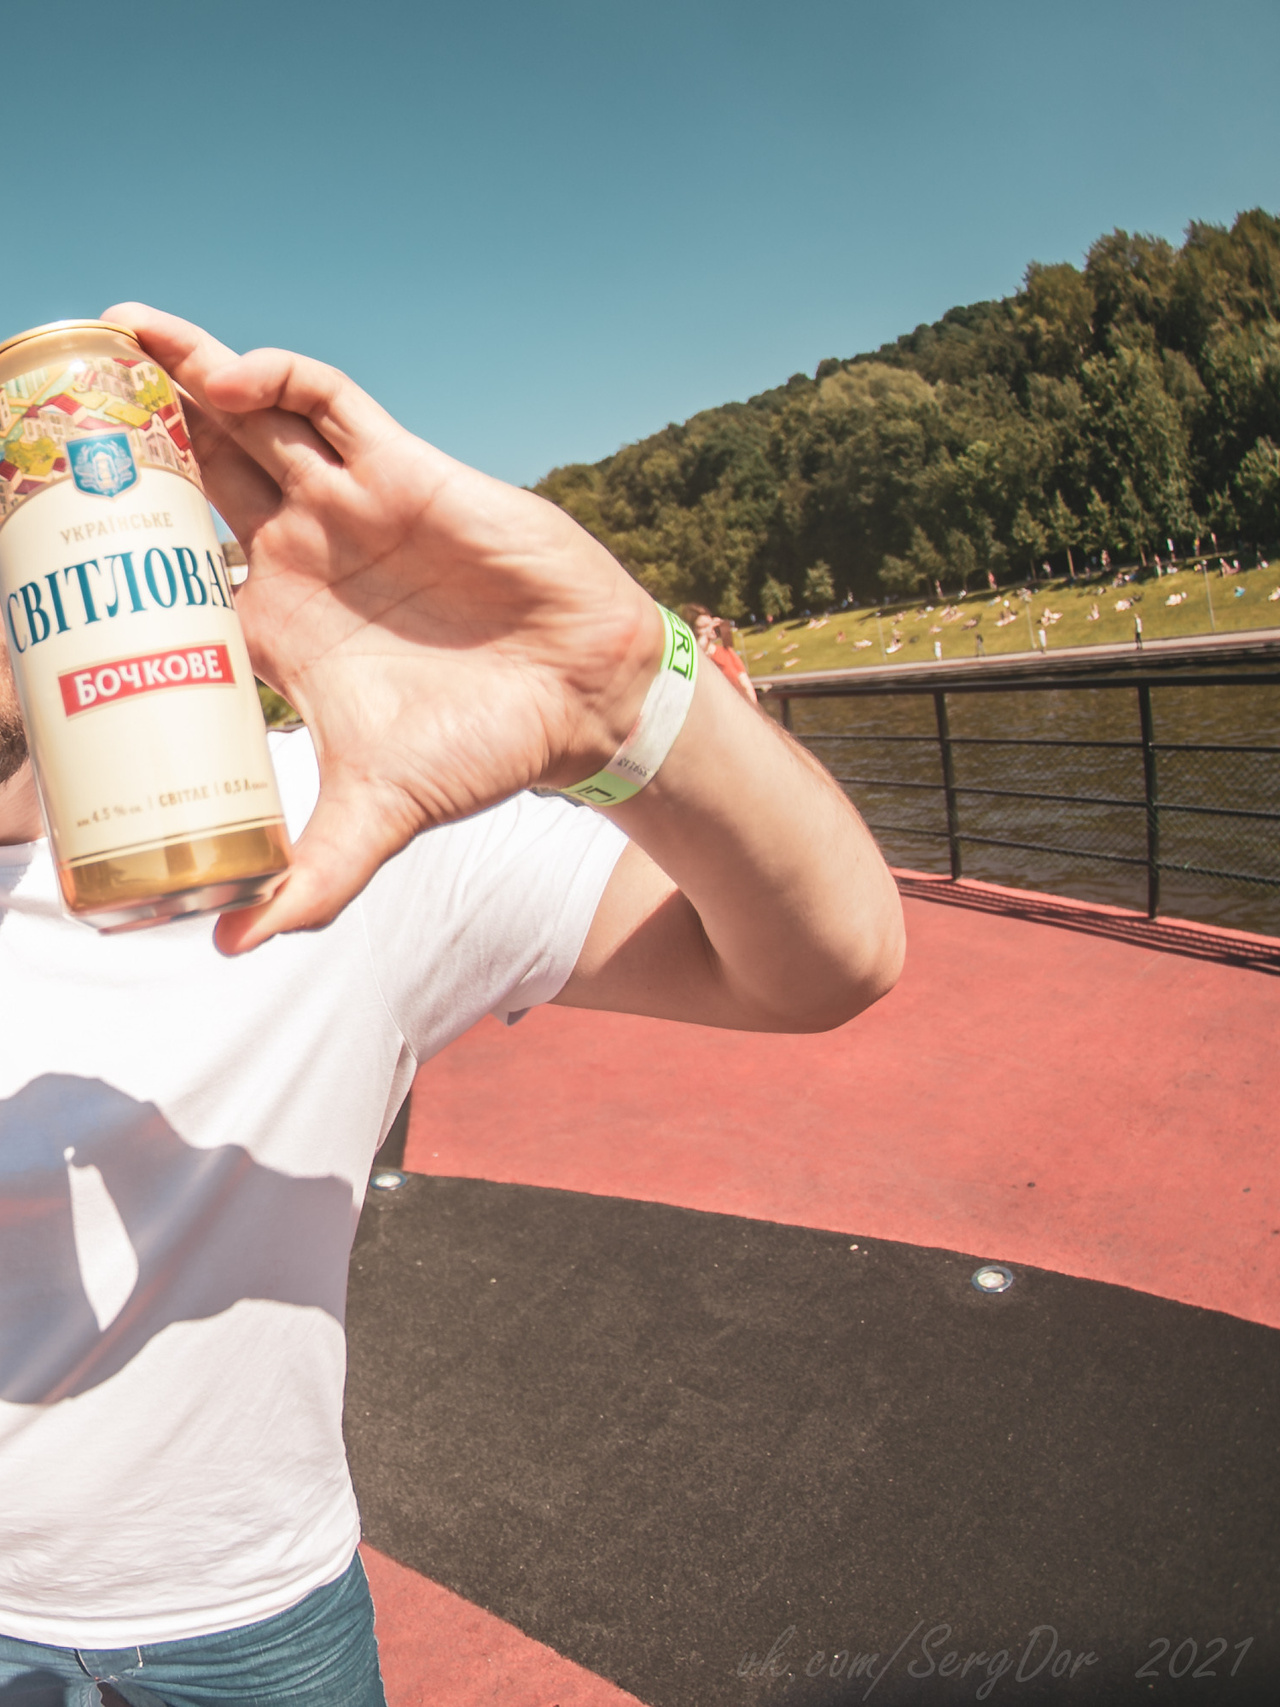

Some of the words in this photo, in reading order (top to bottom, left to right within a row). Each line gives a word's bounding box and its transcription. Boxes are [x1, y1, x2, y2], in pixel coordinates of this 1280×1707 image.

[59, 511, 174, 545] УКРАЇНСЬКЕ
[6, 546, 235, 654] СВІТЛОВА
[73, 649, 223, 707] БОЧКОВЕ
